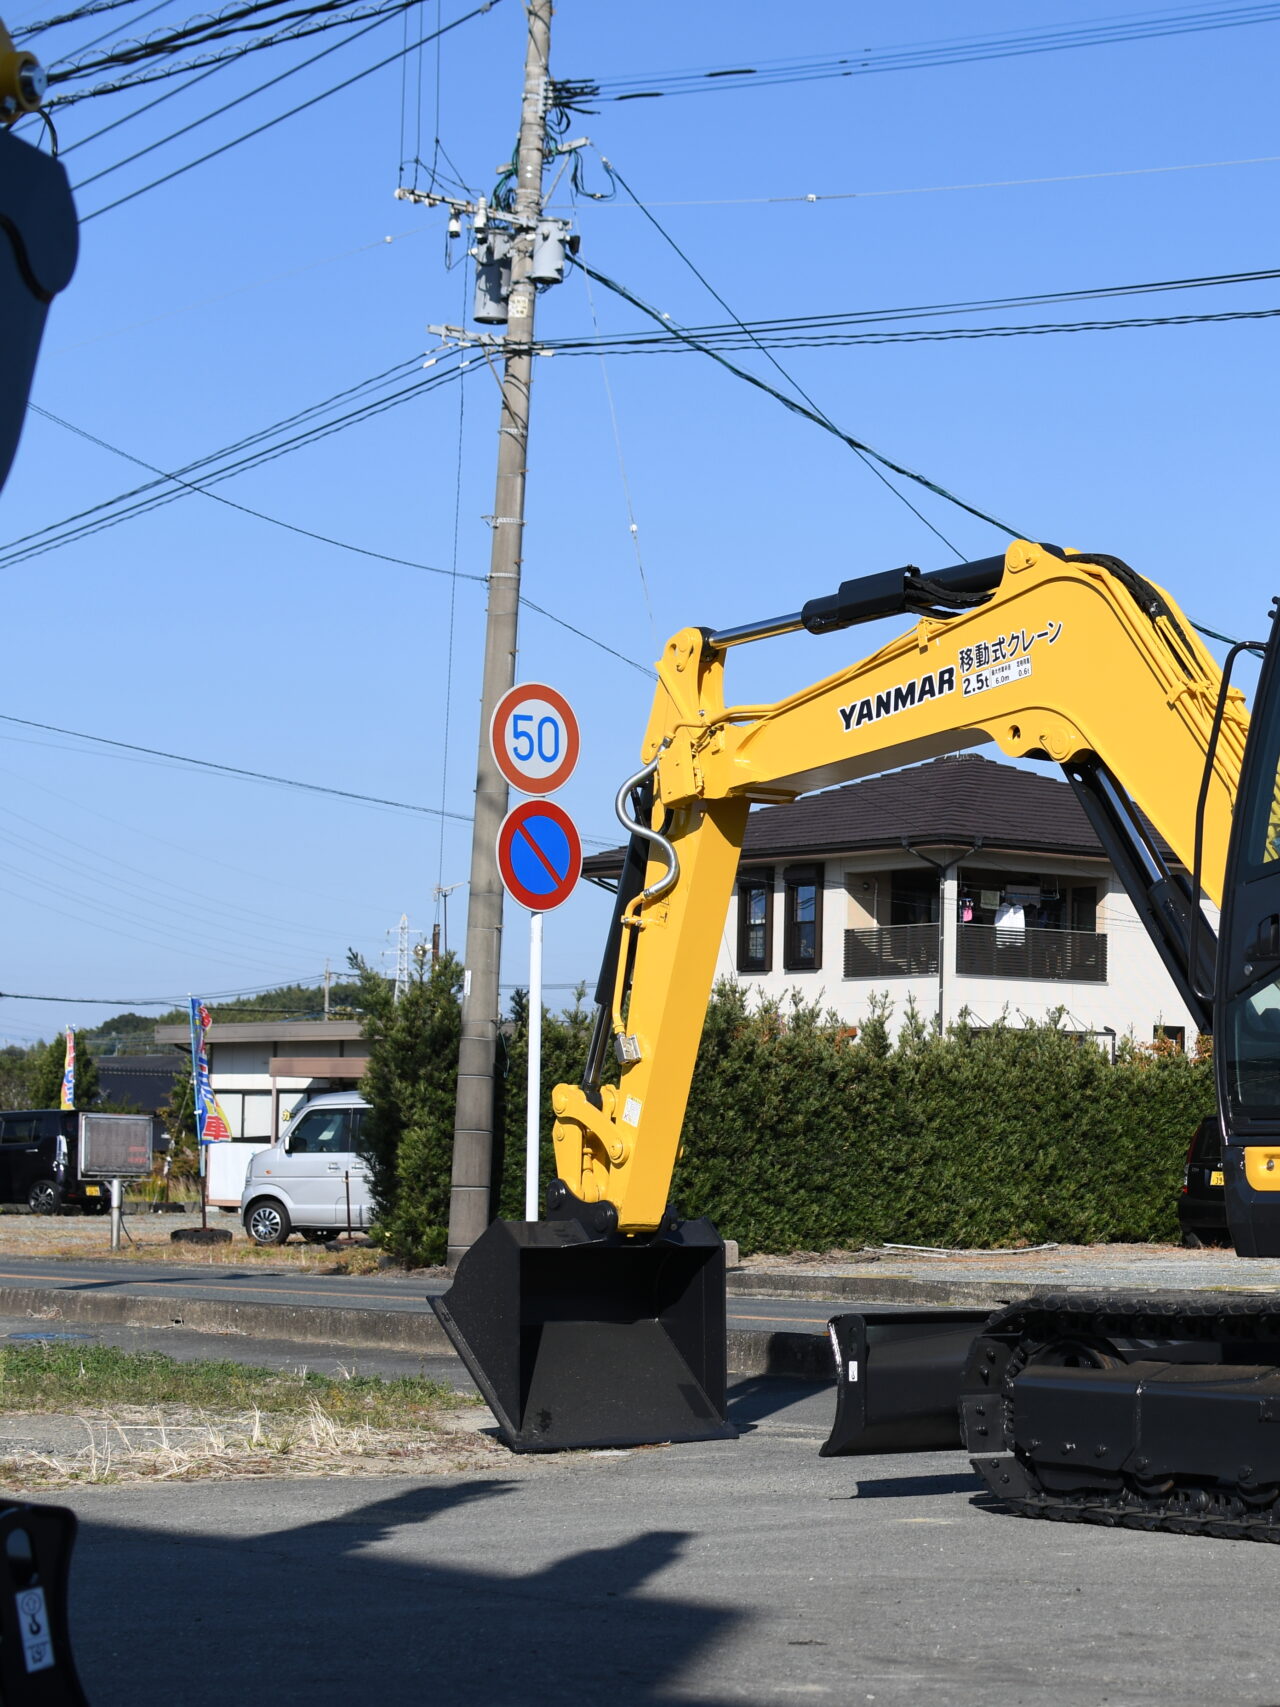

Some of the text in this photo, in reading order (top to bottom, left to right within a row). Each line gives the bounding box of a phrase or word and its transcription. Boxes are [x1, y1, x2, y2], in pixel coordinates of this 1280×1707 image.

[959, 622, 1062, 674] 移動式クレーン
[838, 660, 956, 731] YANMAR
[963, 673, 990, 695] 2.5t
[995, 675, 1010, 685] 6.0m
[512, 714, 560, 763] 50
